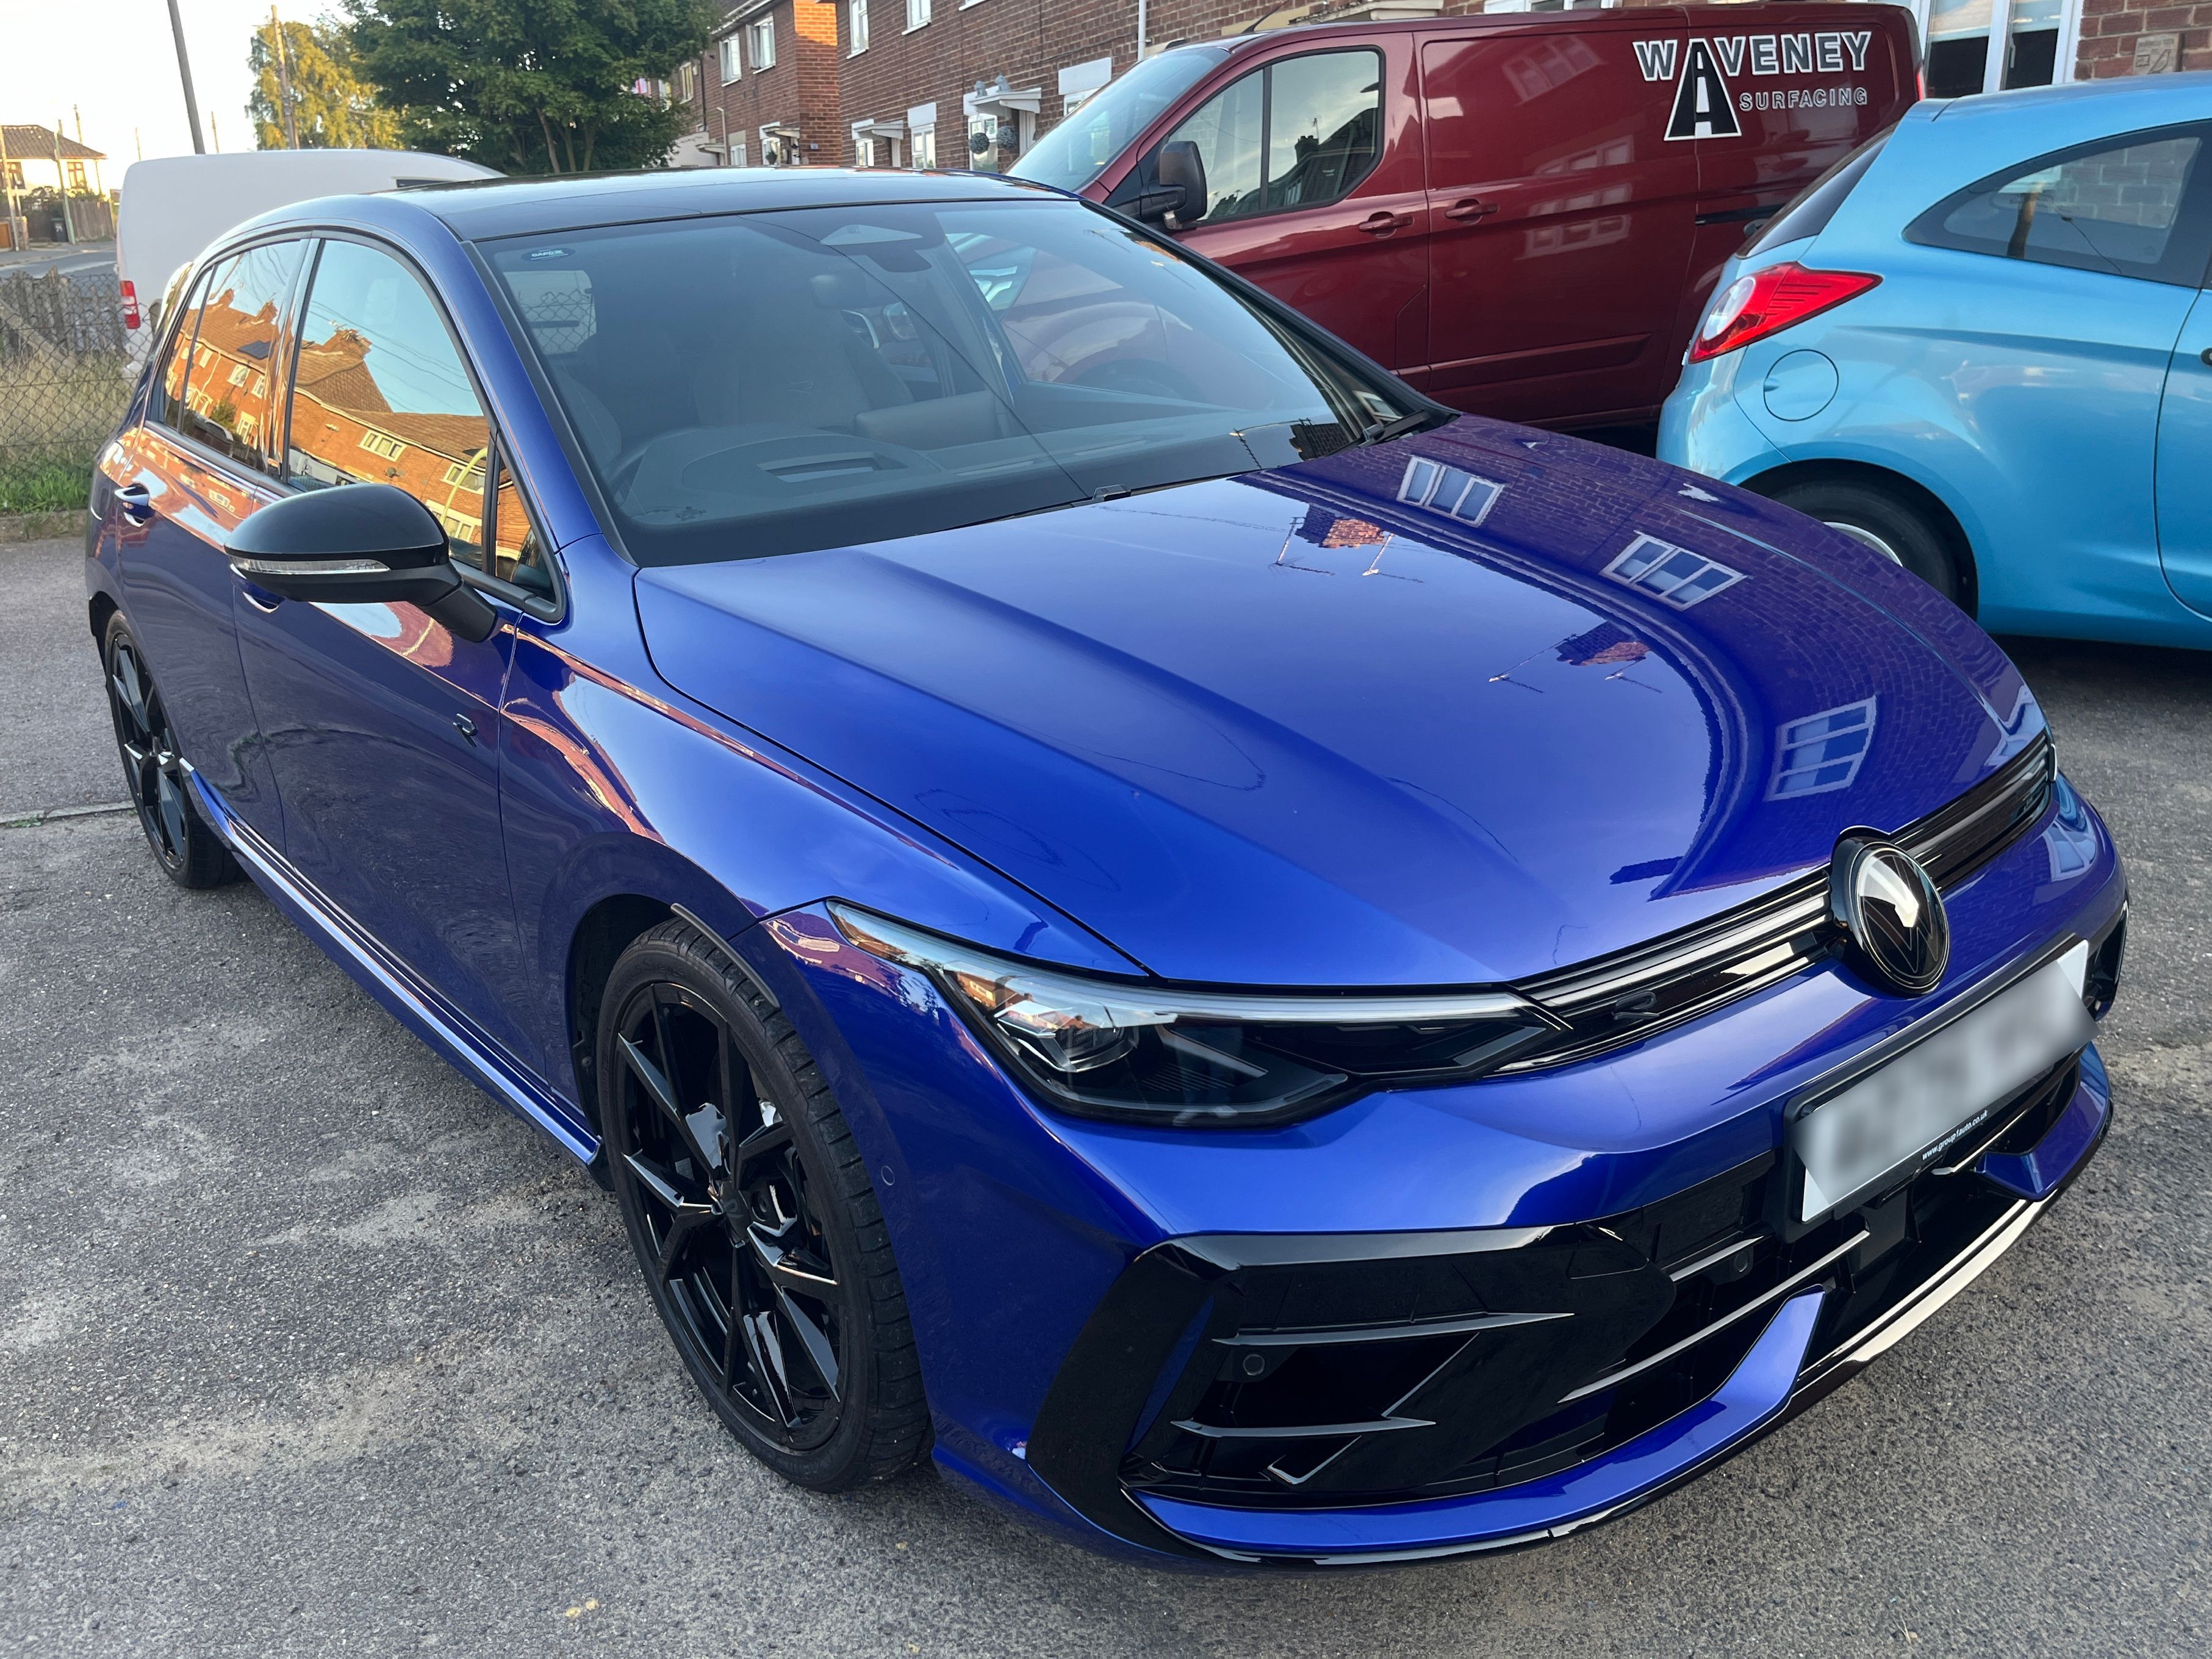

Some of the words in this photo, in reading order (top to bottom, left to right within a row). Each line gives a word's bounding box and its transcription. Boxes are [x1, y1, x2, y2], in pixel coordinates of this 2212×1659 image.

[1632, 30, 1872, 142] WAVENEY
[1739, 87, 1868, 112] SURFACING
[1922, 1109, 1989, 1161] www.group1auto.co.uk
